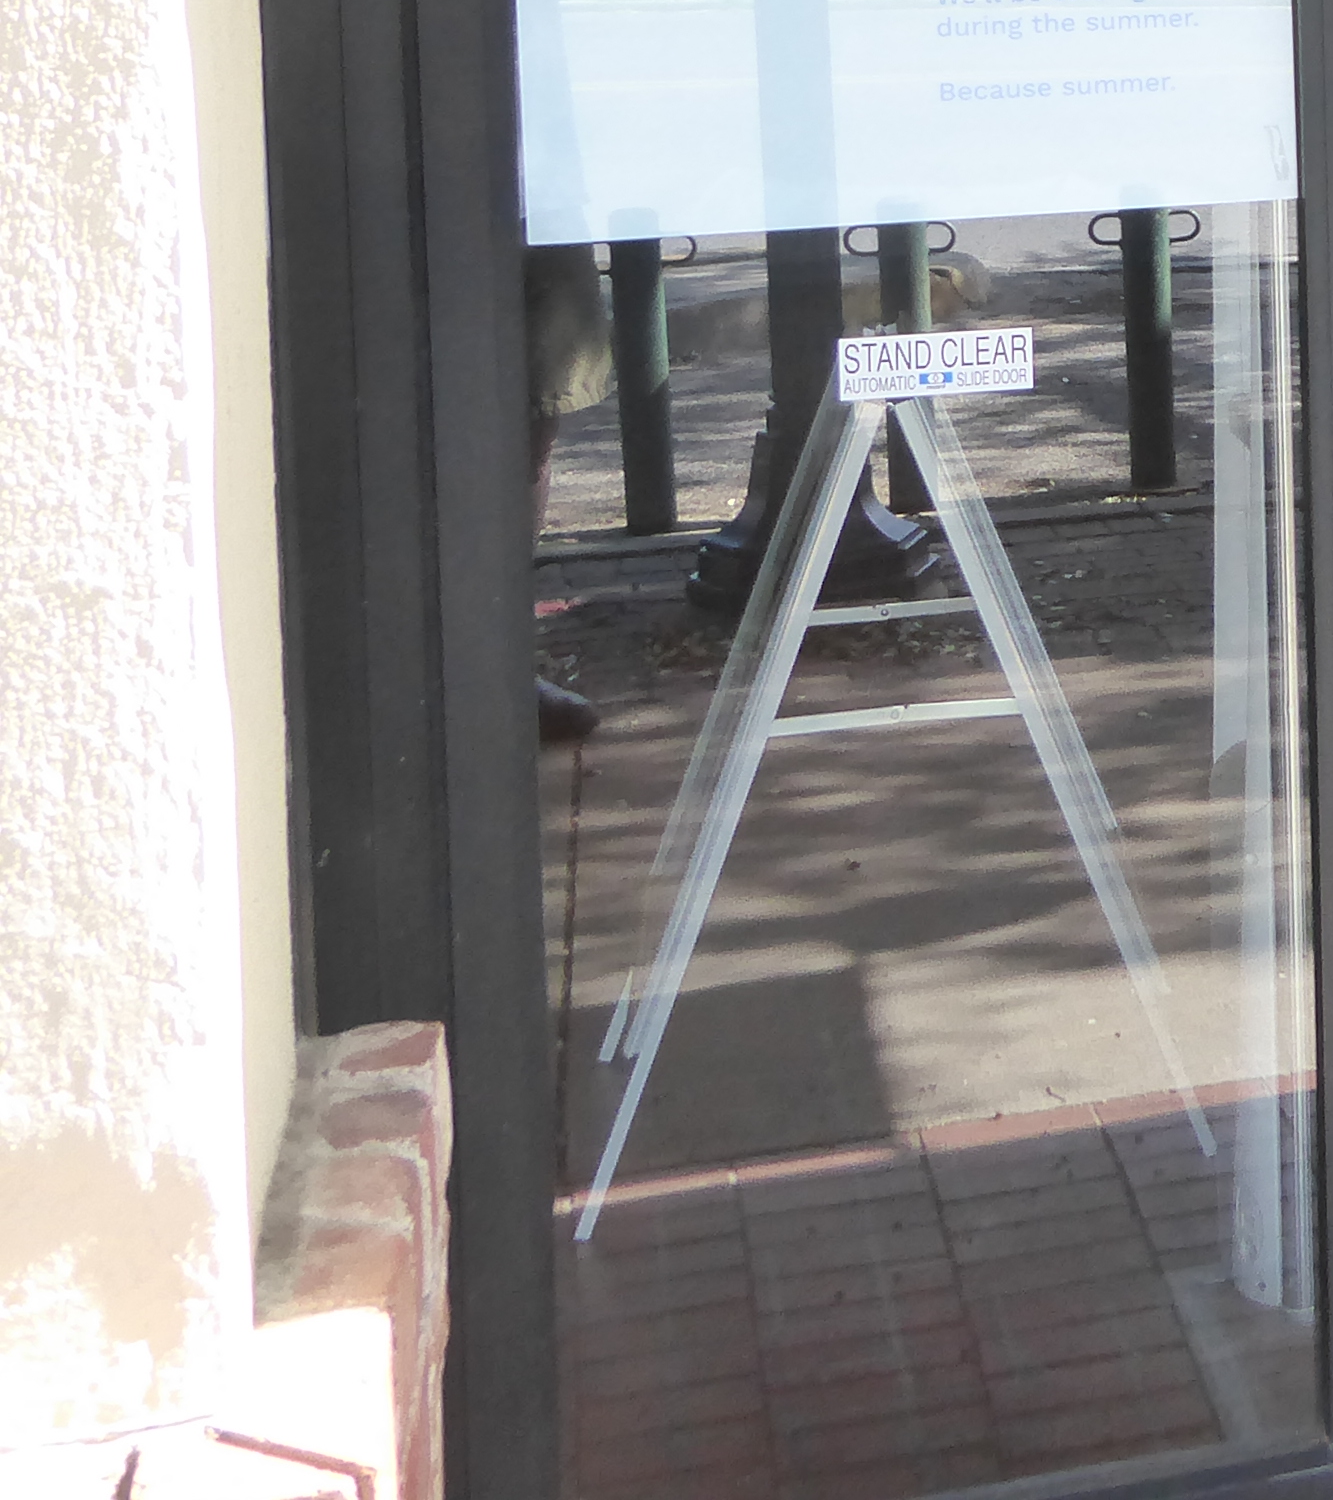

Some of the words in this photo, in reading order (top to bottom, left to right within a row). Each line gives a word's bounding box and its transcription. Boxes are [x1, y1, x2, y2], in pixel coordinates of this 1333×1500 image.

[937, 15, 1023, 40] during
[1031, 12, 1076, 33] the
[1086, 11, 1199, 32] summer.
[940, 81, 1051, 101] Because
[1062, 75, 1176, 96] summer.
[844, 340, 931, 374] STAND
[941, 334, 1028, 368] CLEAR
[844, 375, 916, 394] AUTOMATIC
[957, 370, 989, 387] SLIDE
[993, 368, 1027, 384] DOOR
